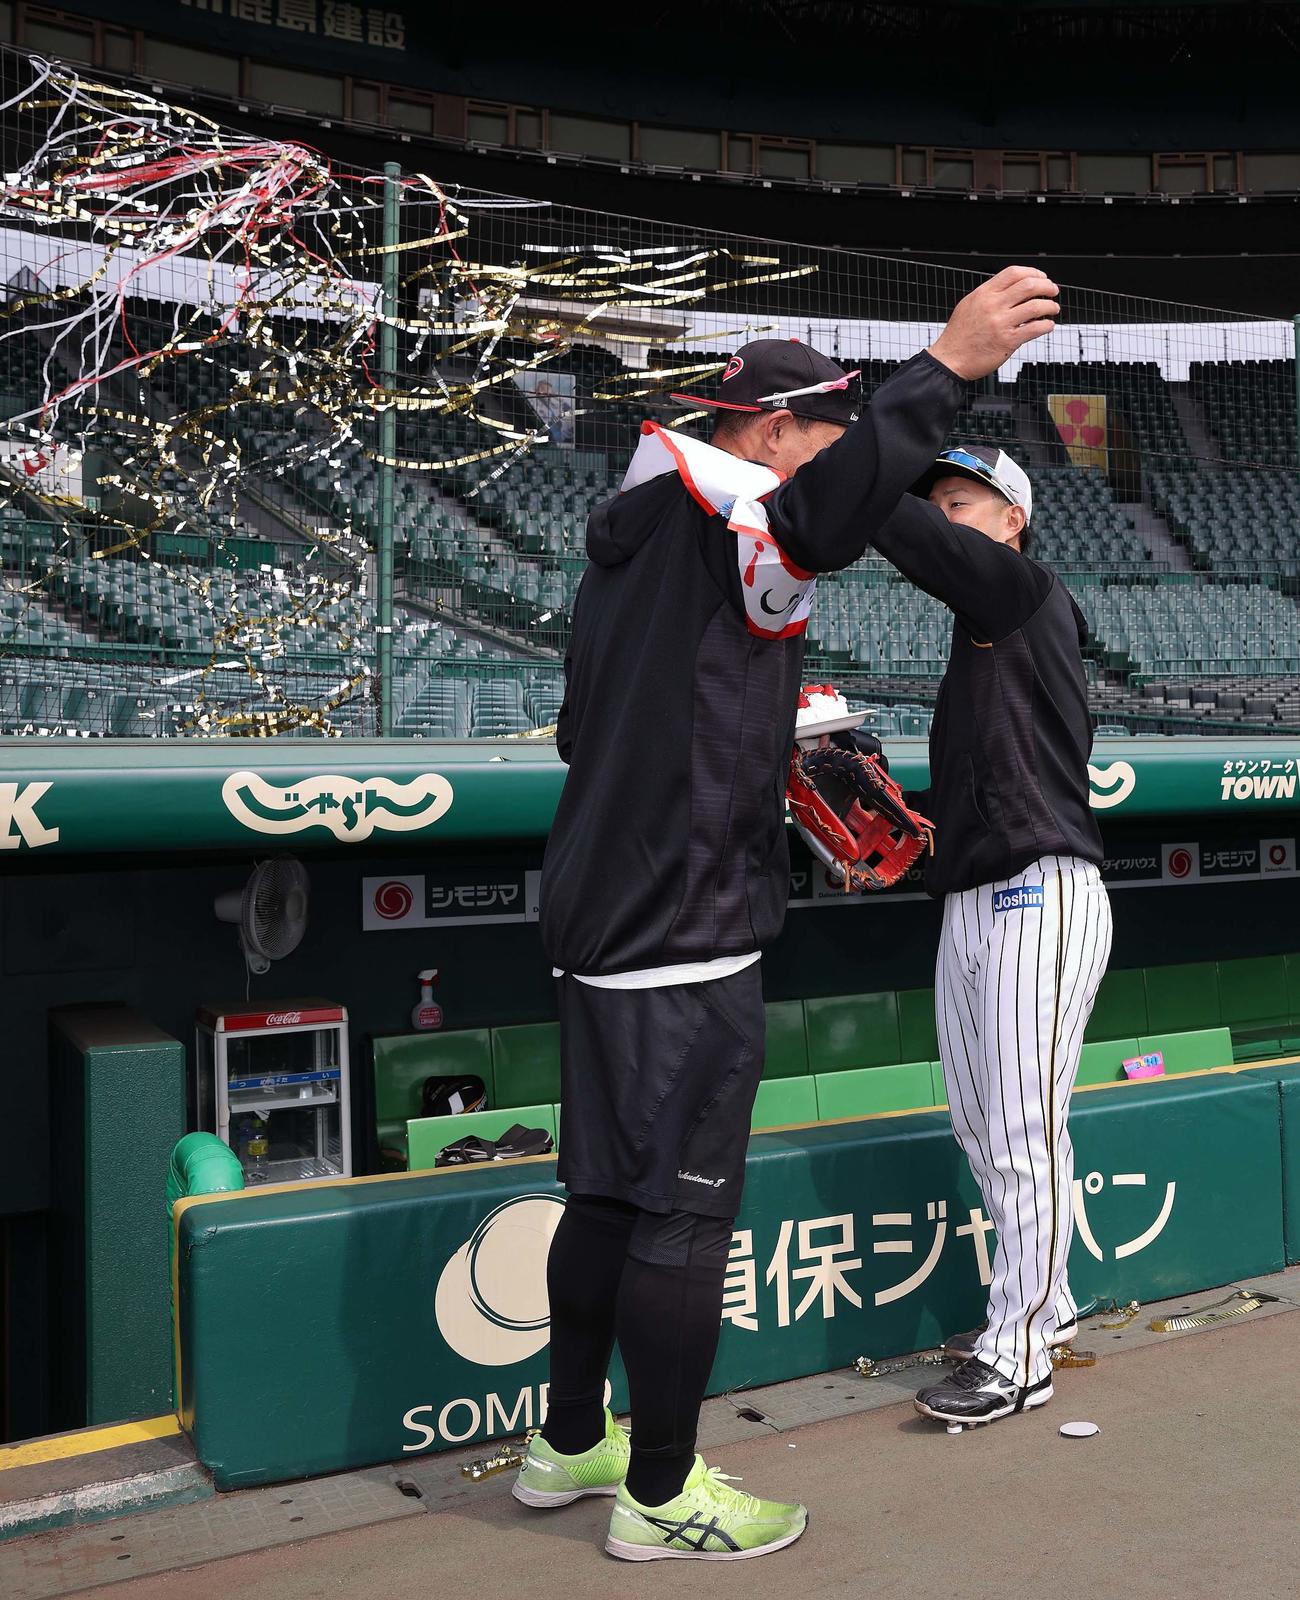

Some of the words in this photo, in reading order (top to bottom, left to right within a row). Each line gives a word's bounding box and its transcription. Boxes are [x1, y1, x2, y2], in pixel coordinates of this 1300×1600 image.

[1222, 759, 1295, 775] タウンワーク
[1220, 775, 1297, 801] TOWN
[1203, 850, 1256, 869] シモジマ
[431, 883, 519, 909] シモジマ
[994, 888, 1043, 910] Joshin
[265, 1011, 302, 1026] Coca-Cola
[402, 1377, 612, 1452] SOM
